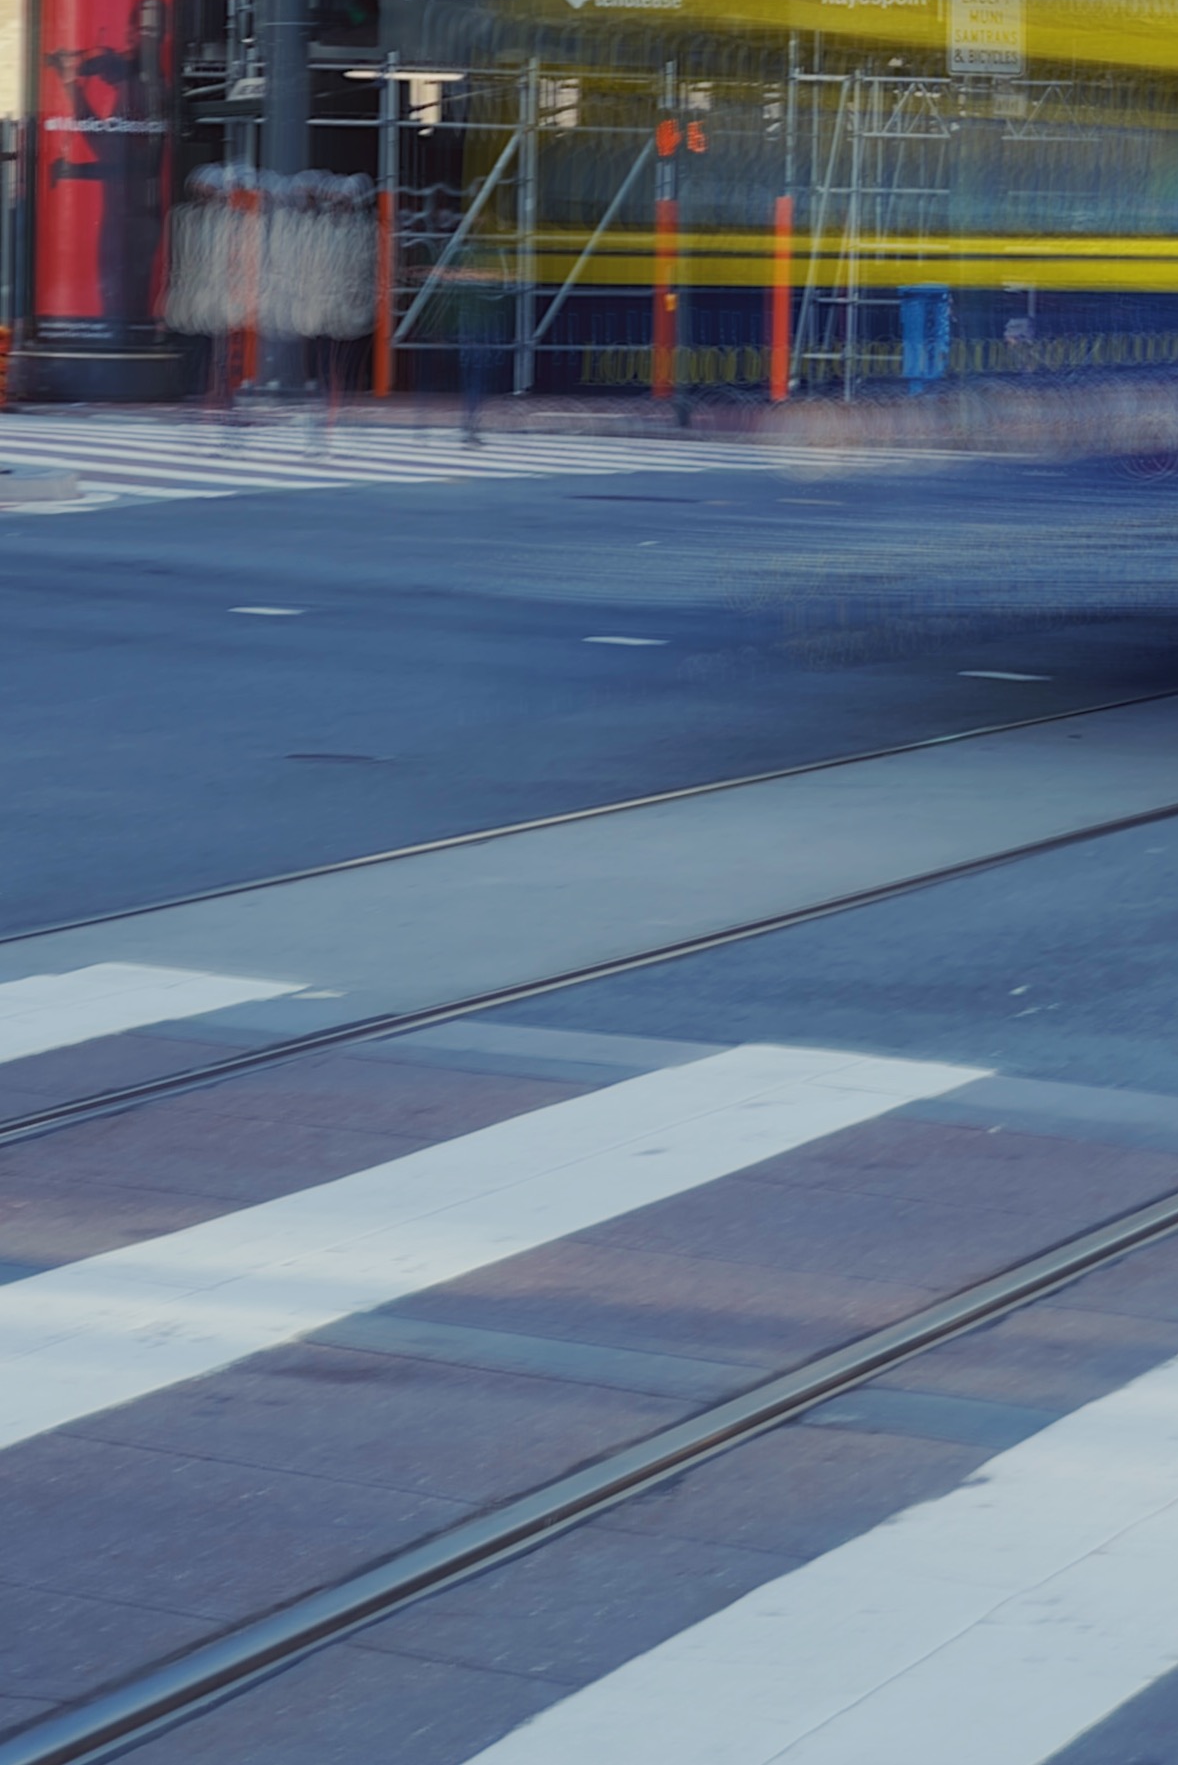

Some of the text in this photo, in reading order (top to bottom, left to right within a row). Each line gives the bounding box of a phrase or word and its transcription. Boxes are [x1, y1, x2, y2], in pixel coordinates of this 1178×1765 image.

[969, 10, 1004, 24] MUNI
[955, 29, 1017, 45] SAMTRANS
[953, 49, 1018, 65] & BICYCLES
